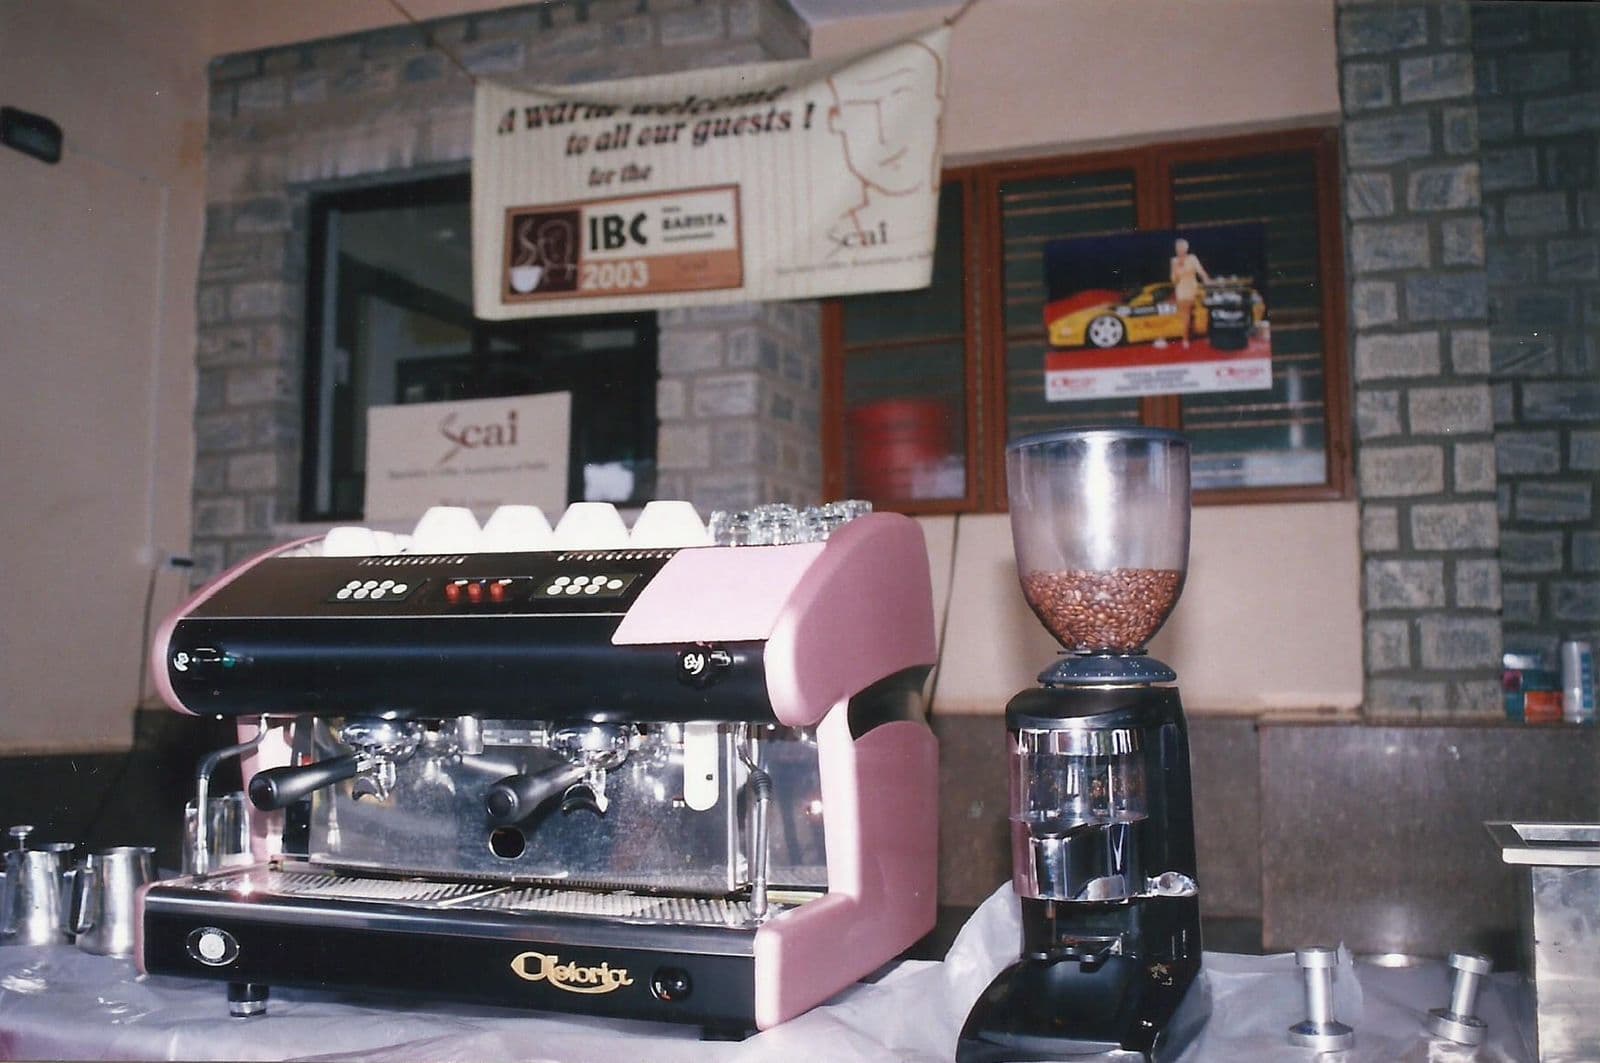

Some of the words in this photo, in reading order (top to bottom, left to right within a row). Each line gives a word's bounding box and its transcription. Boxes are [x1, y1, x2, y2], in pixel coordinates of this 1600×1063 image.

[497, 107, 516, 135] A
[565, 132, 590, 157] to
[595, 122, 631, 152] all
[637, 122, 686, 147] our
[692, 107, 792, 147] guests
[620, 163, 651, 182] the
[588, 212, 648, 251] IBC
[581, 258, 650, 290] 2003
